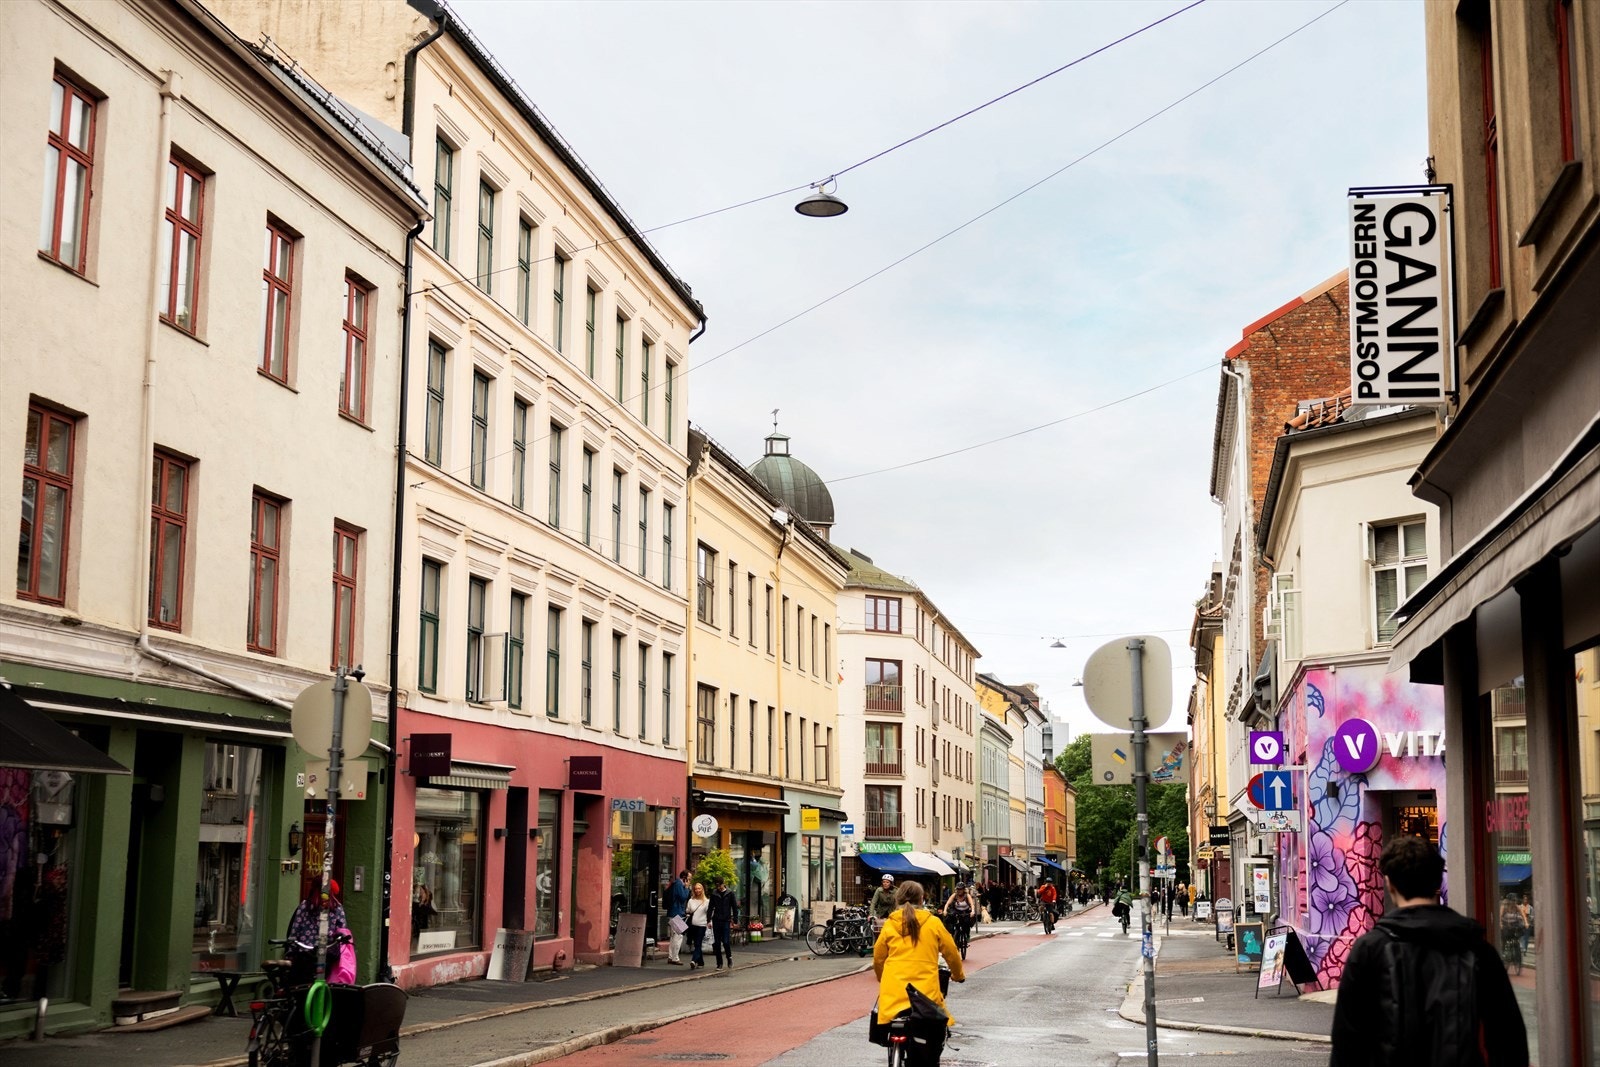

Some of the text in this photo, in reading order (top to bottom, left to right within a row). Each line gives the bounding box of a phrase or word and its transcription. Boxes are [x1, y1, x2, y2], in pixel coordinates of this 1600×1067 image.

[1354, 203, 1380, 399] POSTMODERN
[1383, 202, 1440, 398] GANNI
[613, 799, 644, 811] PAST
[862, 843, 897, 851] MEVLANA
